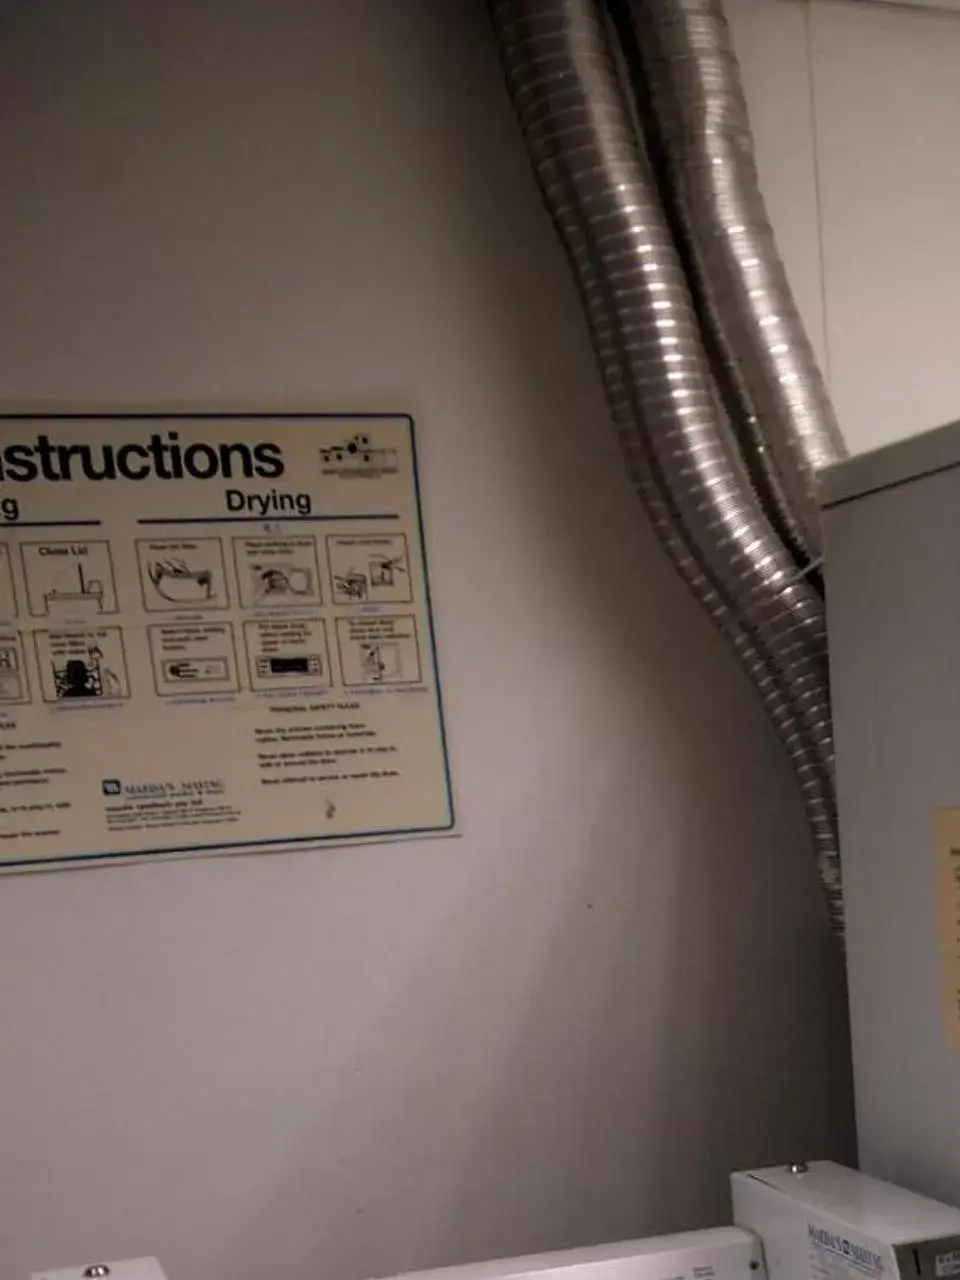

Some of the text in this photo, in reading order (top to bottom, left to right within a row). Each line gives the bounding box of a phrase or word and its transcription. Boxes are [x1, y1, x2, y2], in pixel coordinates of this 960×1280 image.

[0, 432, 284, 482] structions
[0, 498, 19, 521] g
[226, 489, 312, 516] Drying
